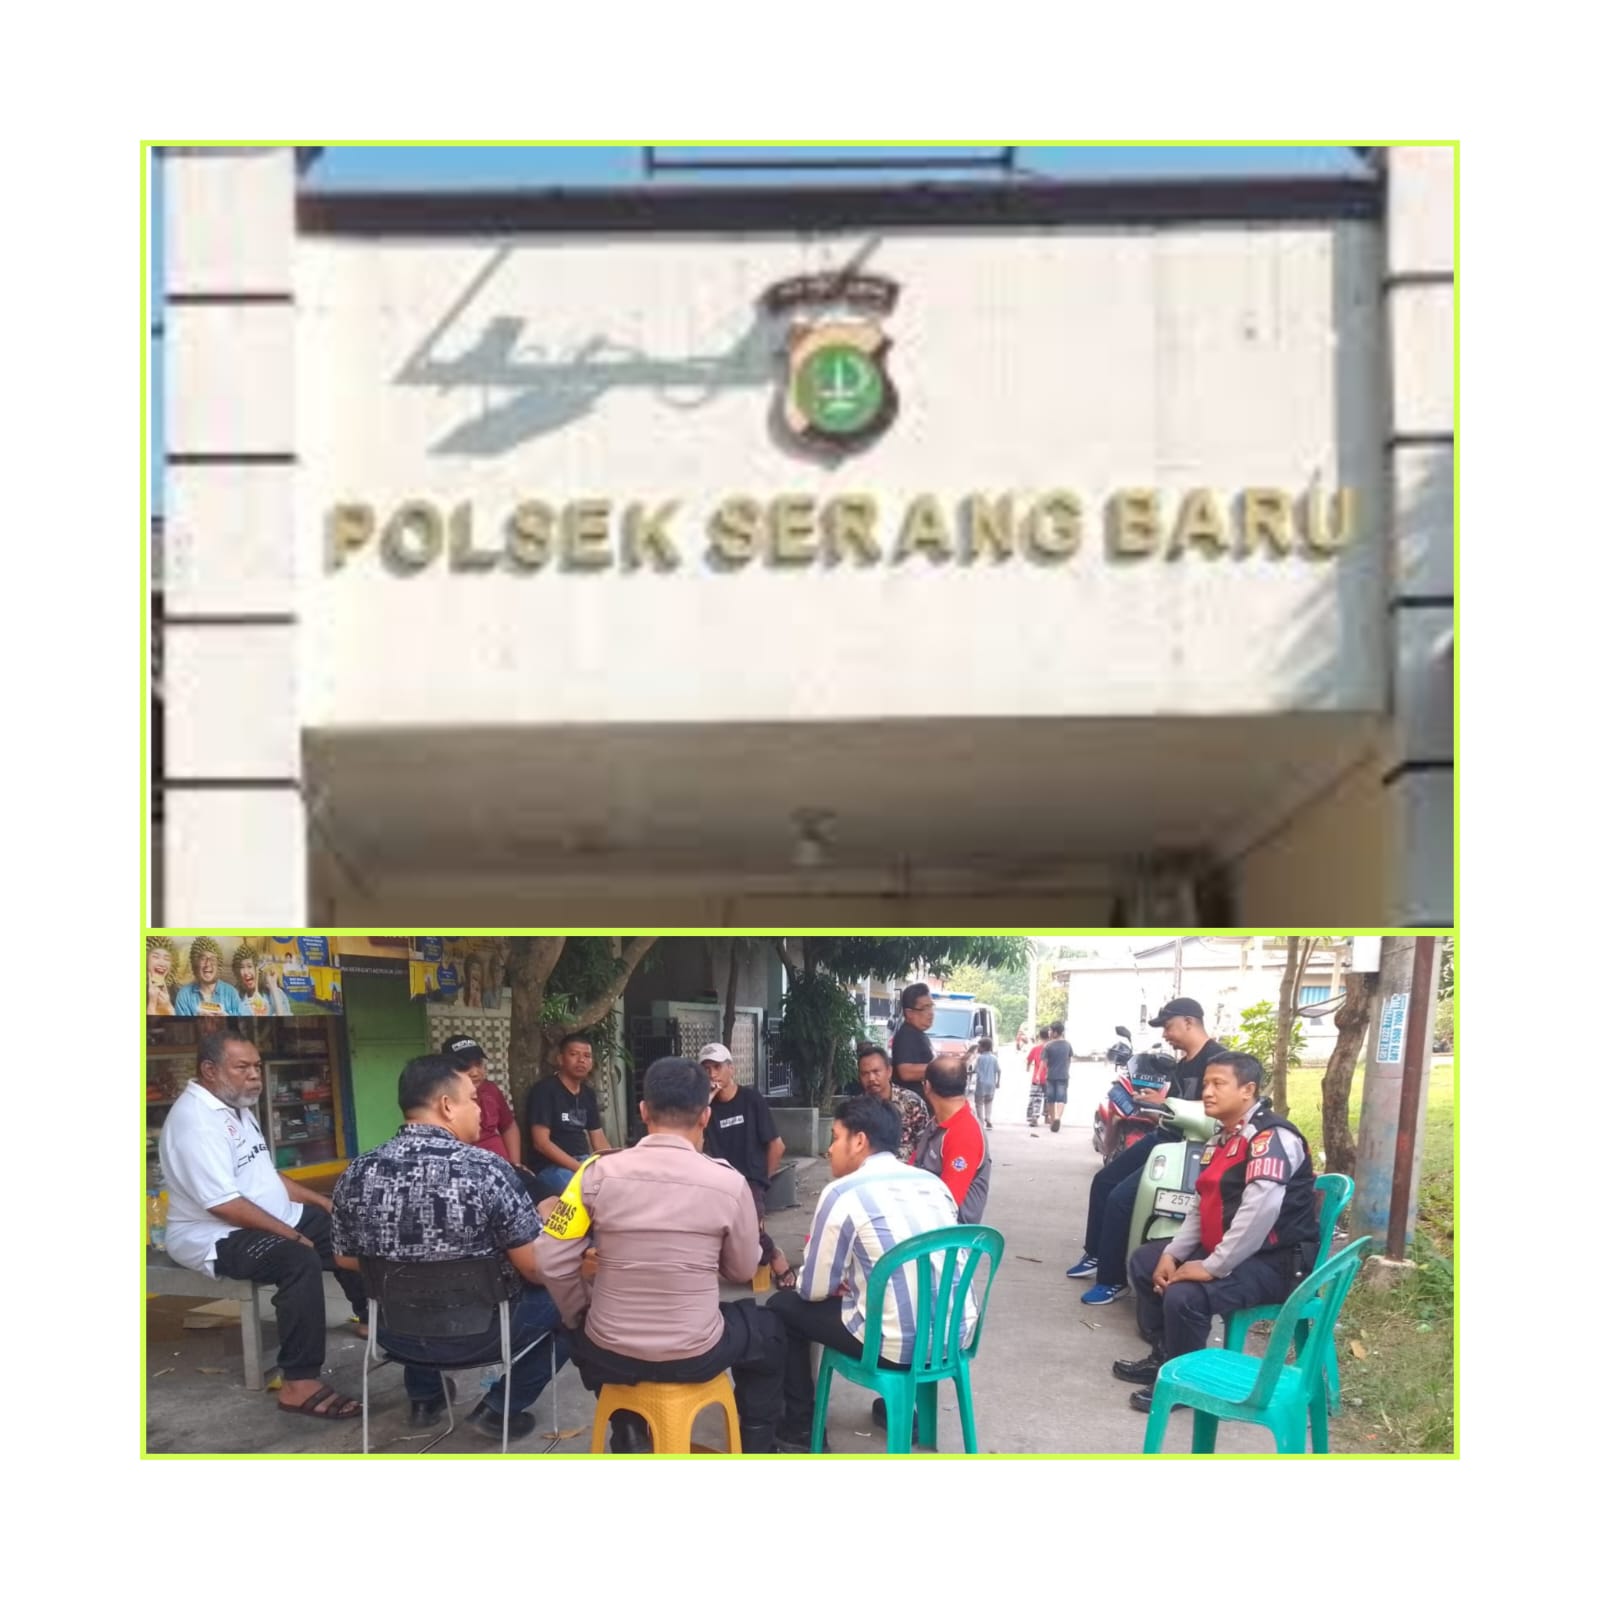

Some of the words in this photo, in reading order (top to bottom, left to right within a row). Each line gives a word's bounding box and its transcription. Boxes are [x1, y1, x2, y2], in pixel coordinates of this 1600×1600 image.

[324, 499, 682, 577] POLSEK
[704, 489, 1083, 572] SERANG
[1103, 486, 1357, 564] BARU
[1171, 1194, 1196, 1206] 257
